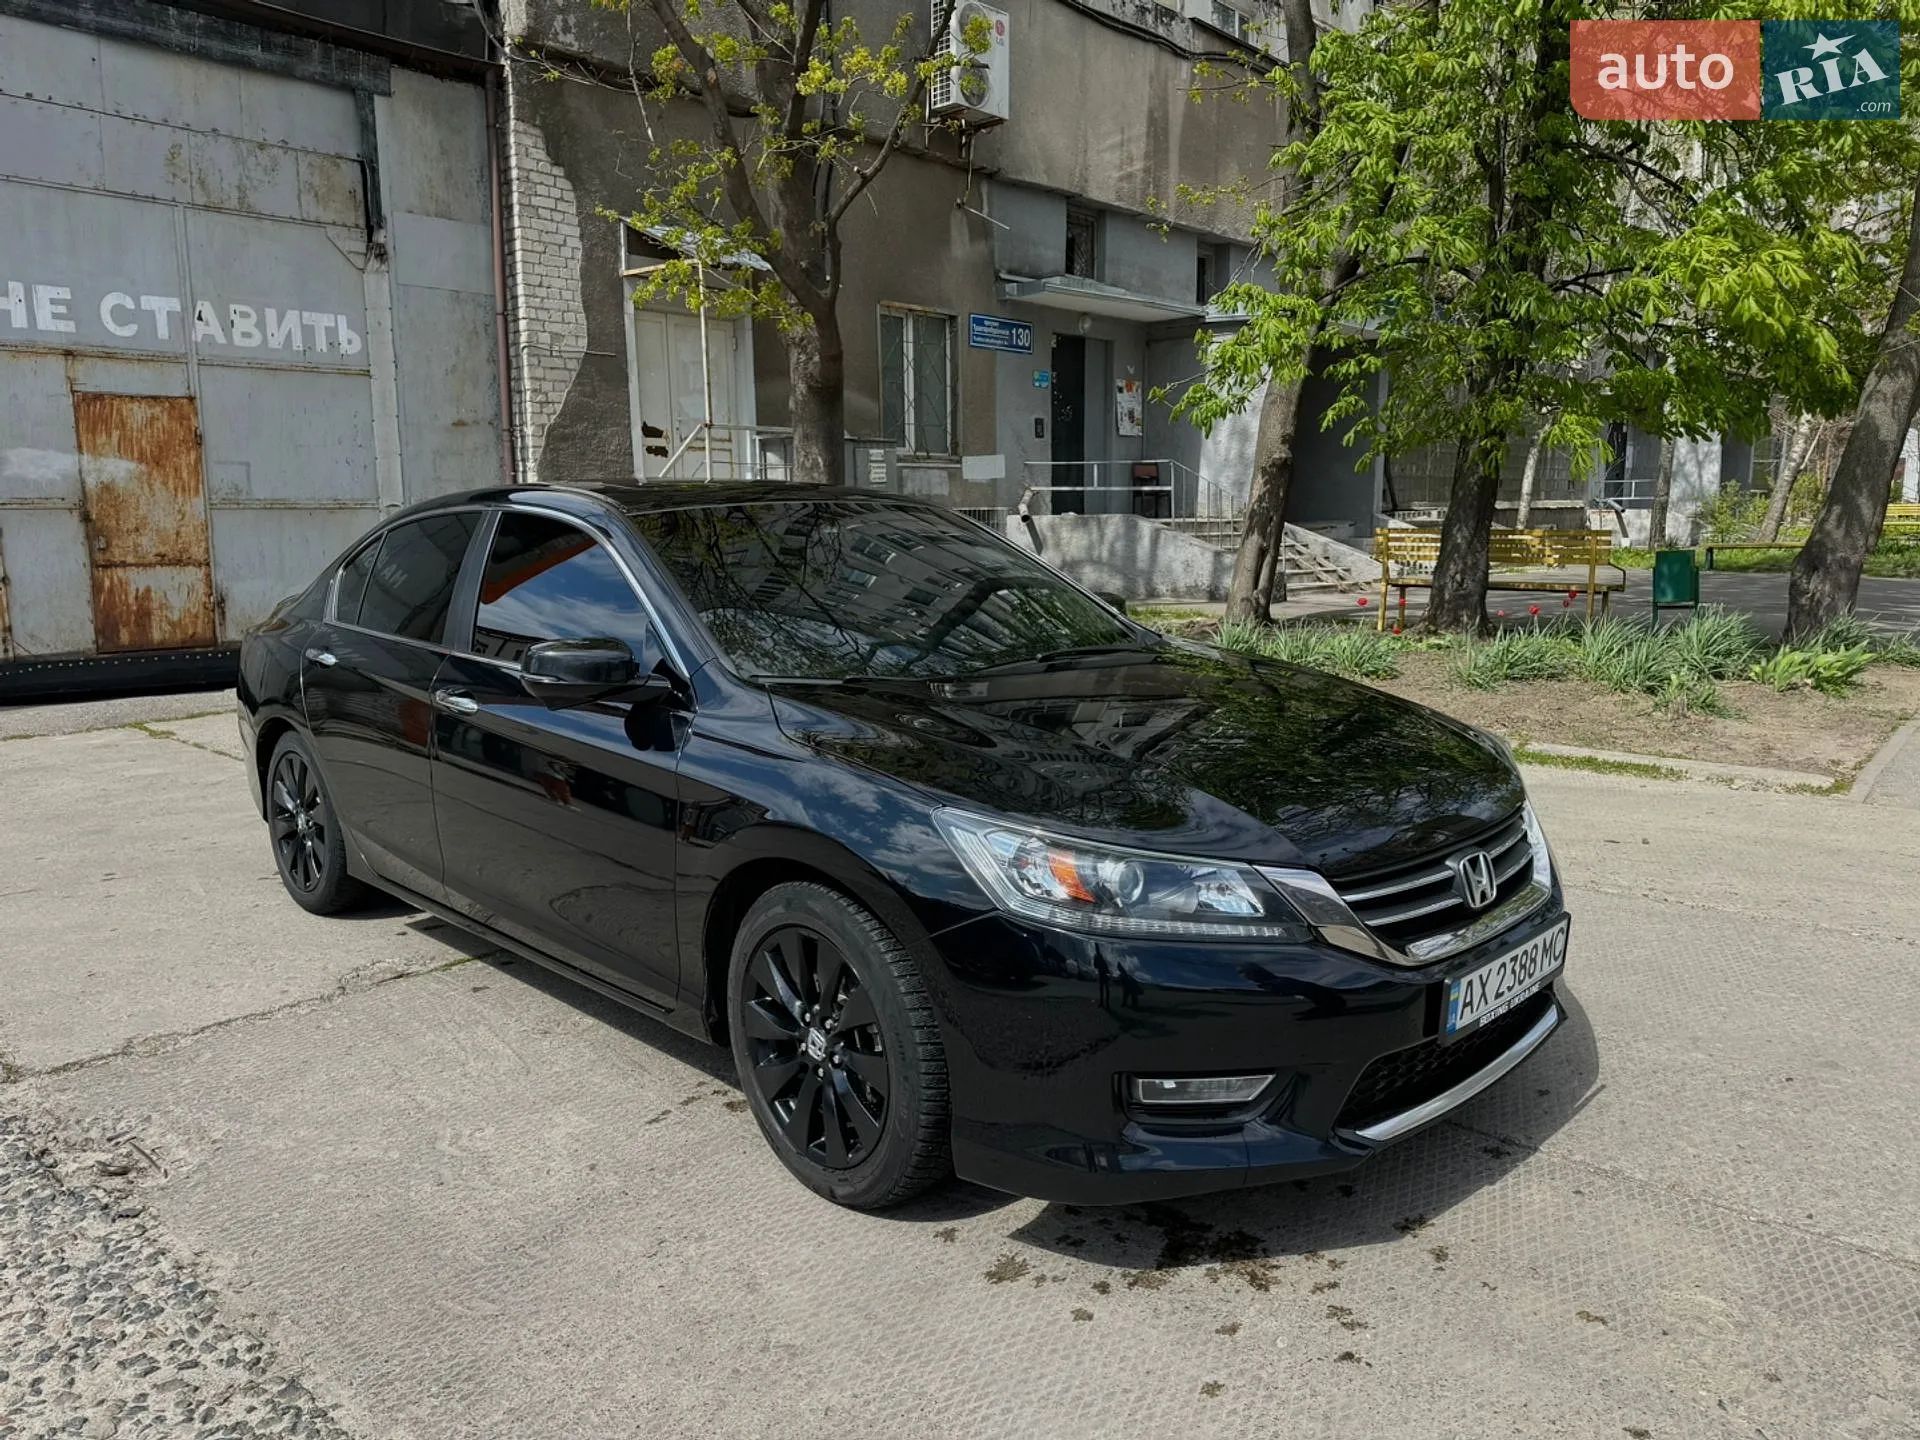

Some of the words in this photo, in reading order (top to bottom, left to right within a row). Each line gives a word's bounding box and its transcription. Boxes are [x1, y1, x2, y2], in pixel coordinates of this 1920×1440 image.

[100, 291, 363, 356] СТАВИТЬ
[1011, 328, 1030, 346] 130
[1459, 968, 1492, 1021] AX
[1494, 943, 1538, 1000] 2388
[1540, 926, 1565, 972] MC
